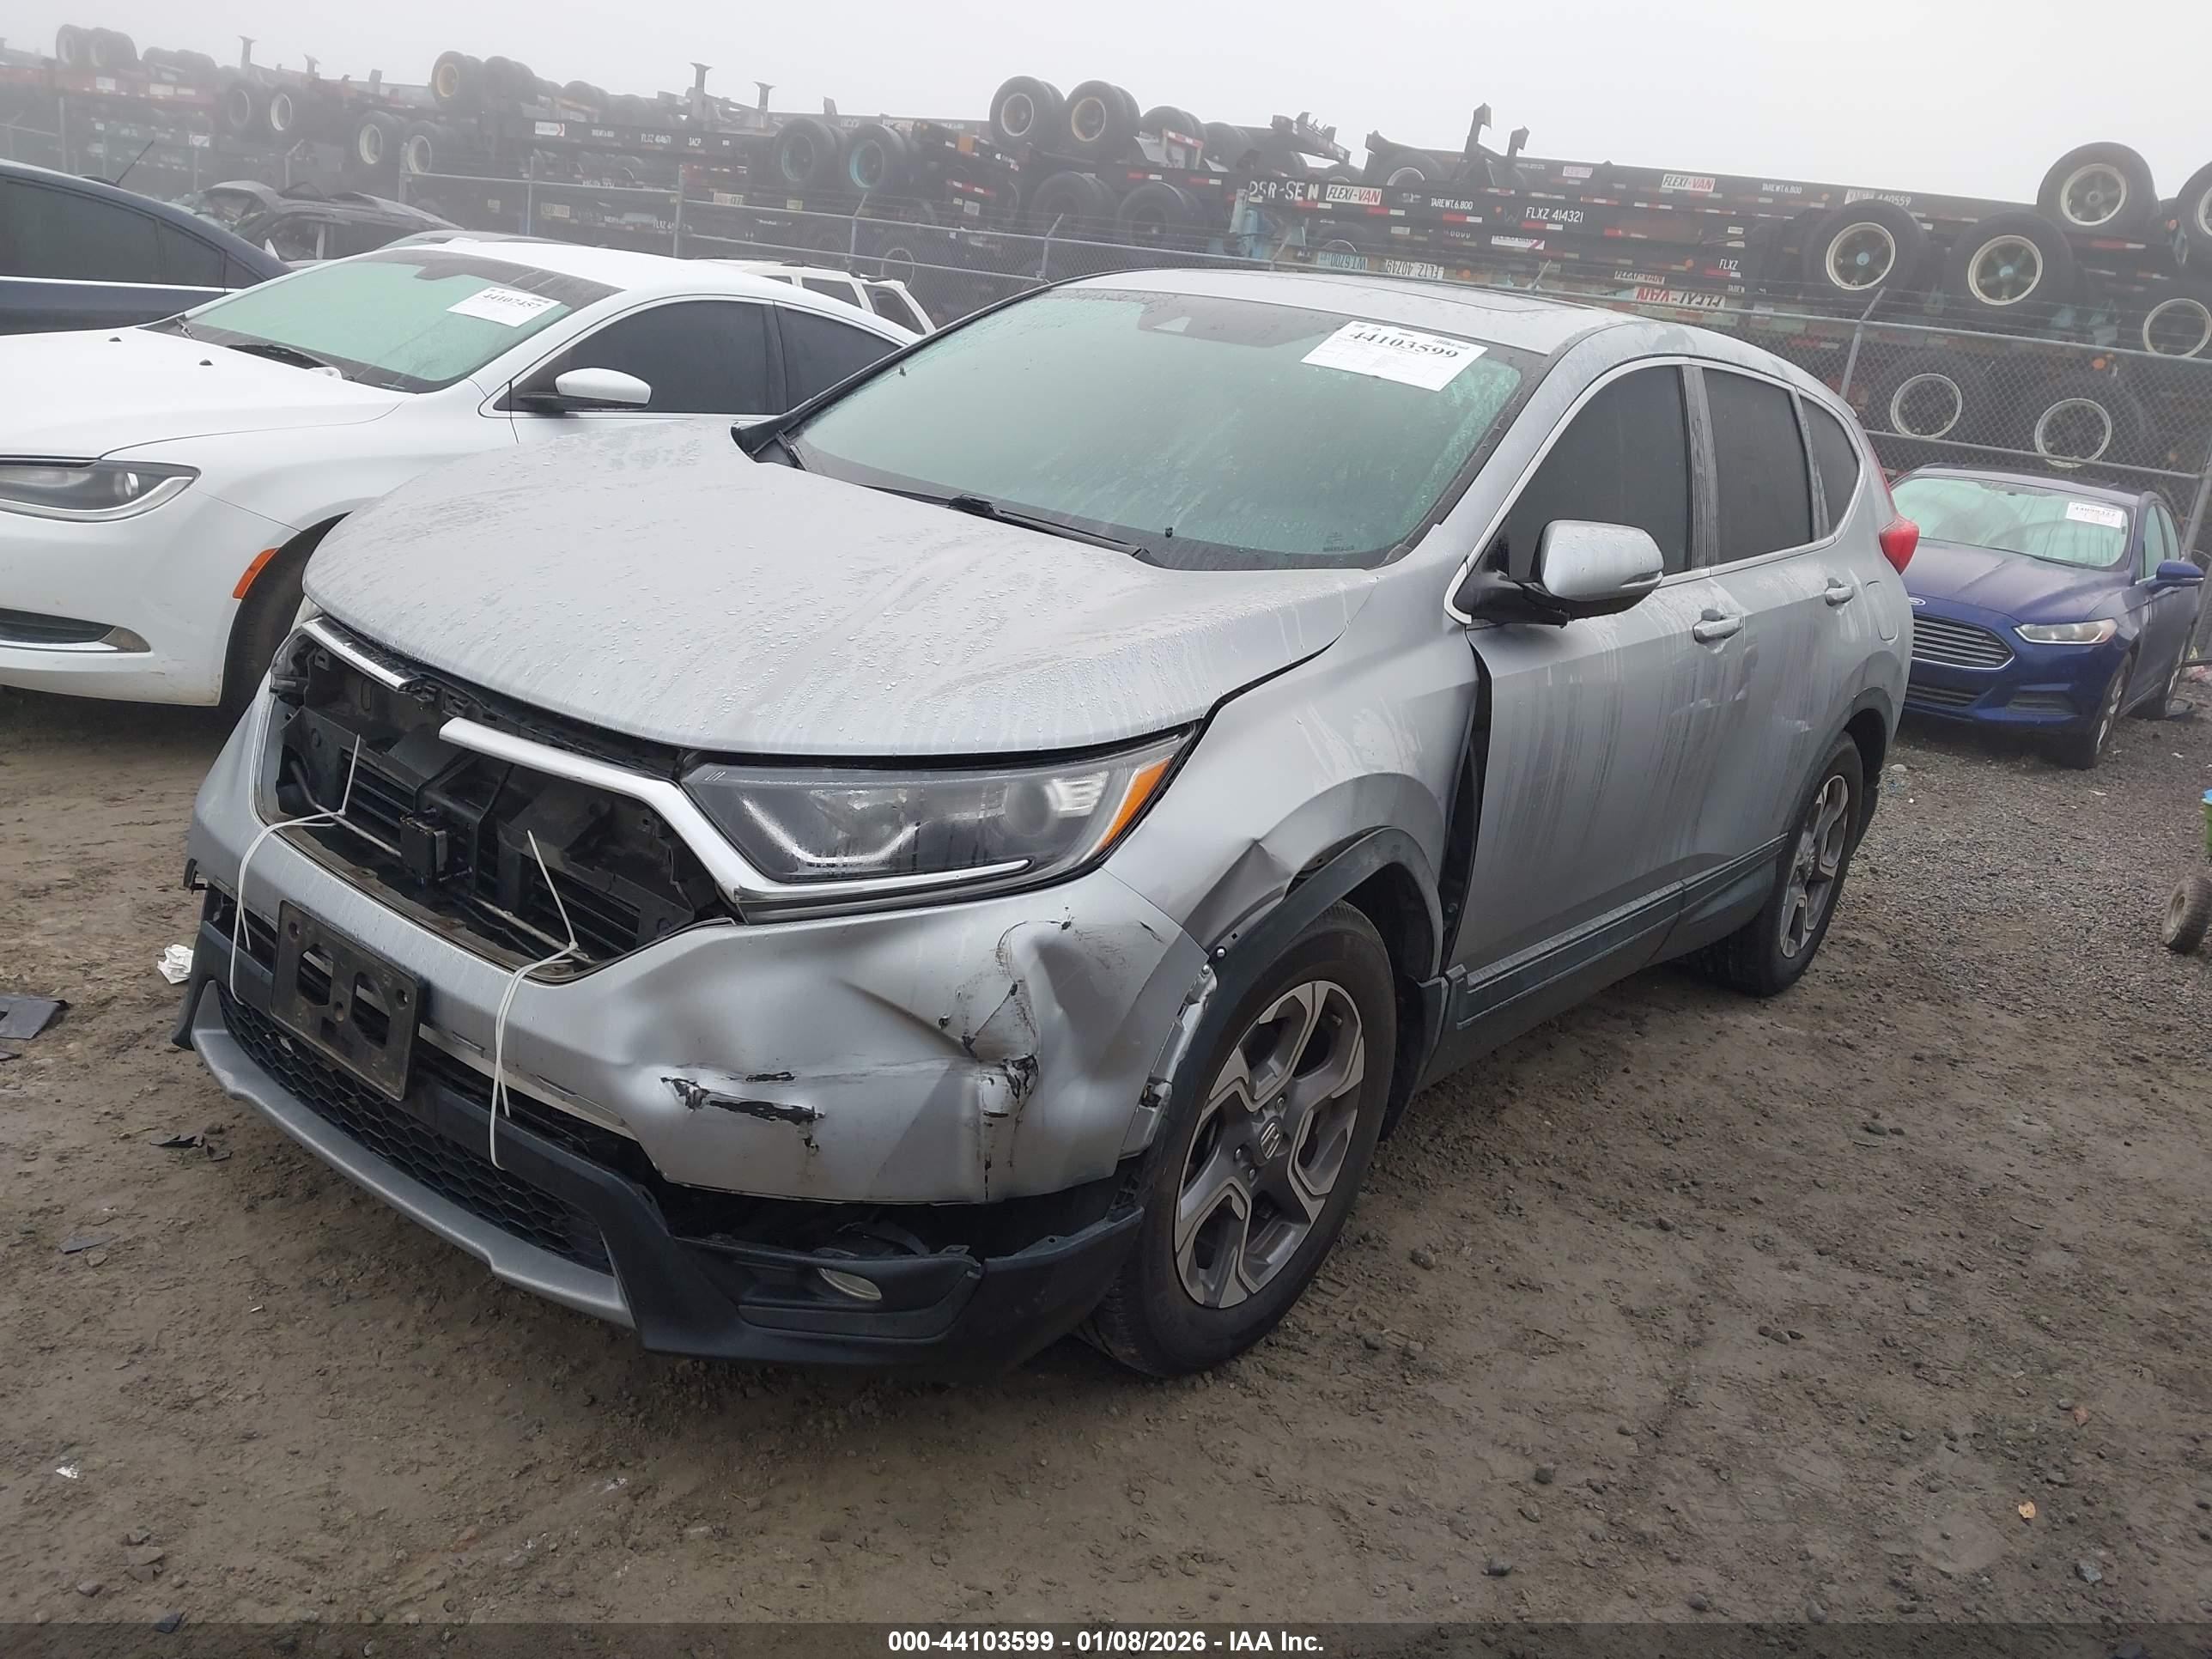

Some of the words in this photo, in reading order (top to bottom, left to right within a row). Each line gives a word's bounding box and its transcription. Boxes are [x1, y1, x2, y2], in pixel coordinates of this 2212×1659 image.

[1664, 177, 1713, 190] FLEXI-VAN
[1328, 185, 1381, 203] FLEXI-VAN
[1526, 206, 1550, 219] FLXZ
[1552, 210, 1584, 223] 414321
[1719, 259, 1739, 270] FLXZ
[1349, 331, 1459, 358] 44103599
